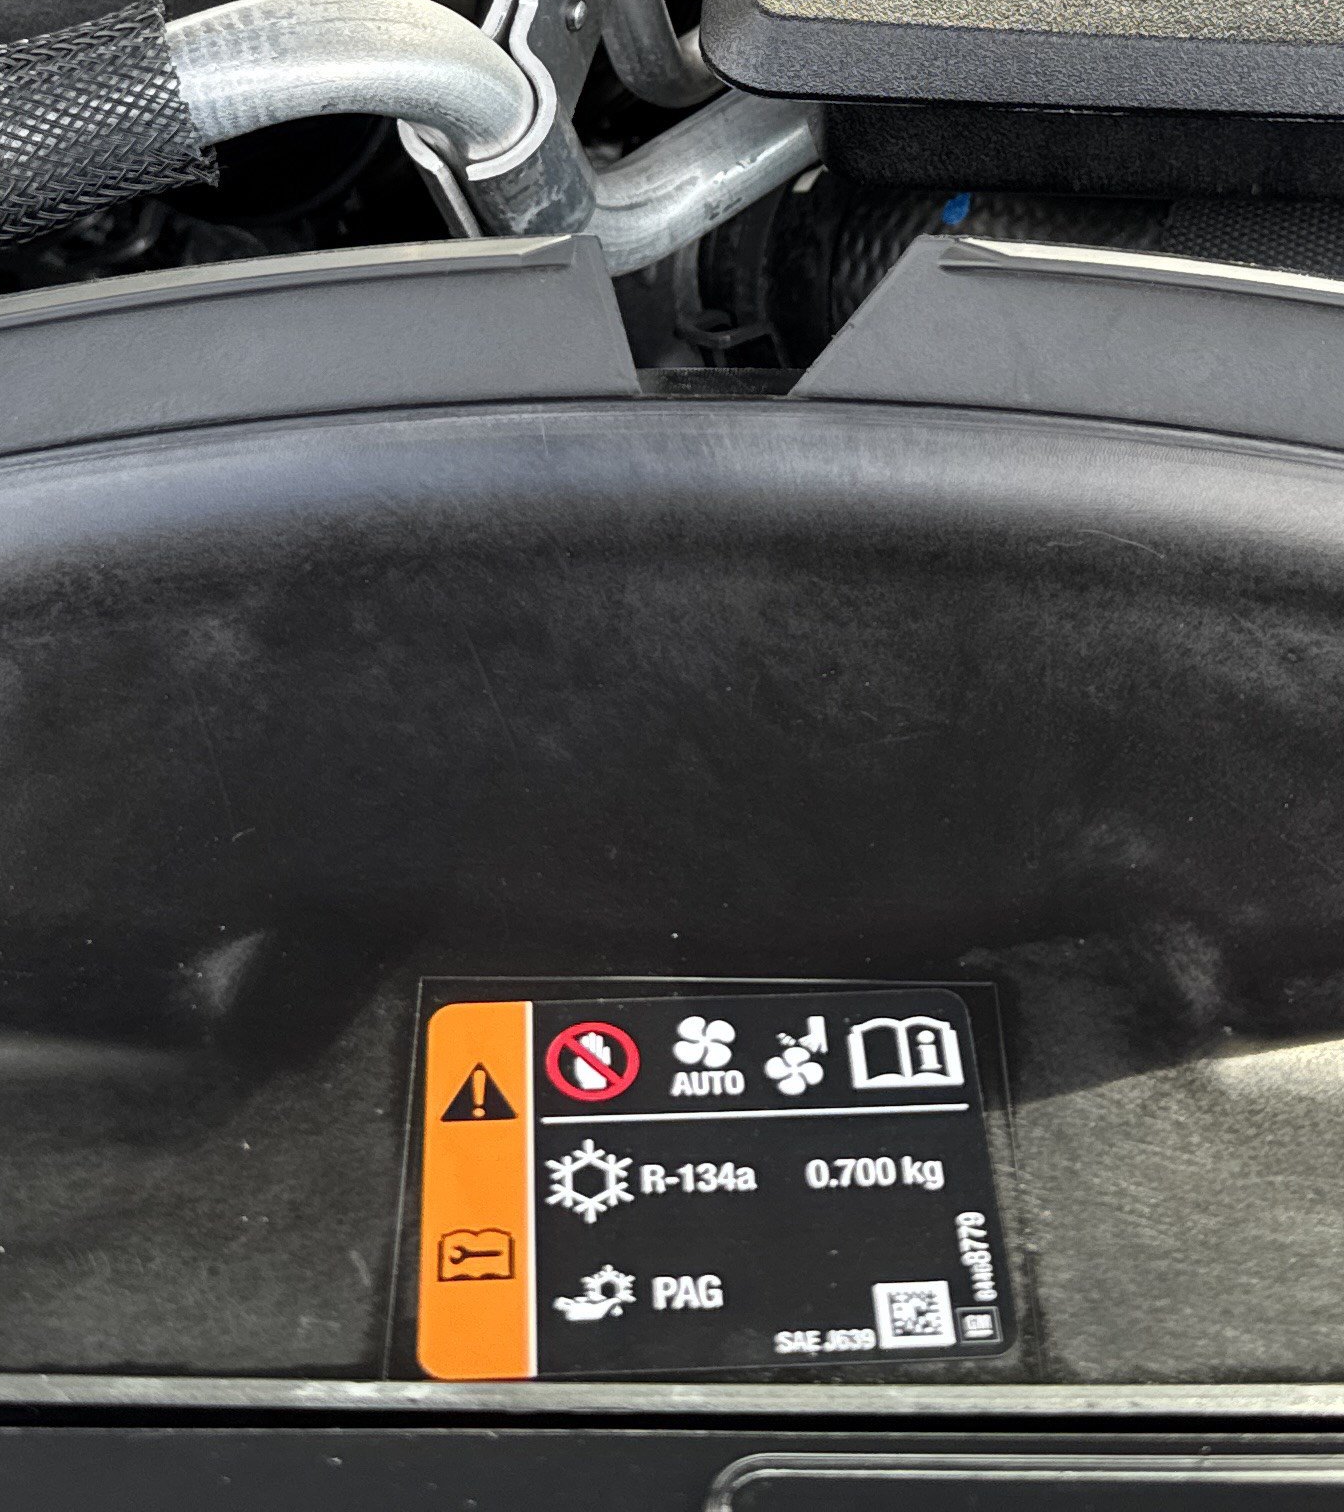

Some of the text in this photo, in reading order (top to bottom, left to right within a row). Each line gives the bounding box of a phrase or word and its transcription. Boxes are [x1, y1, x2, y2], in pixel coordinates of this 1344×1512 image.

[671, 1069, 745, 1096] AUTO
[640, 1156, 945, 1194] R-134a 0.700 kg
[651, 1274, 724, 1311] PAG
[774, 1330, 821, 1353] SAE
